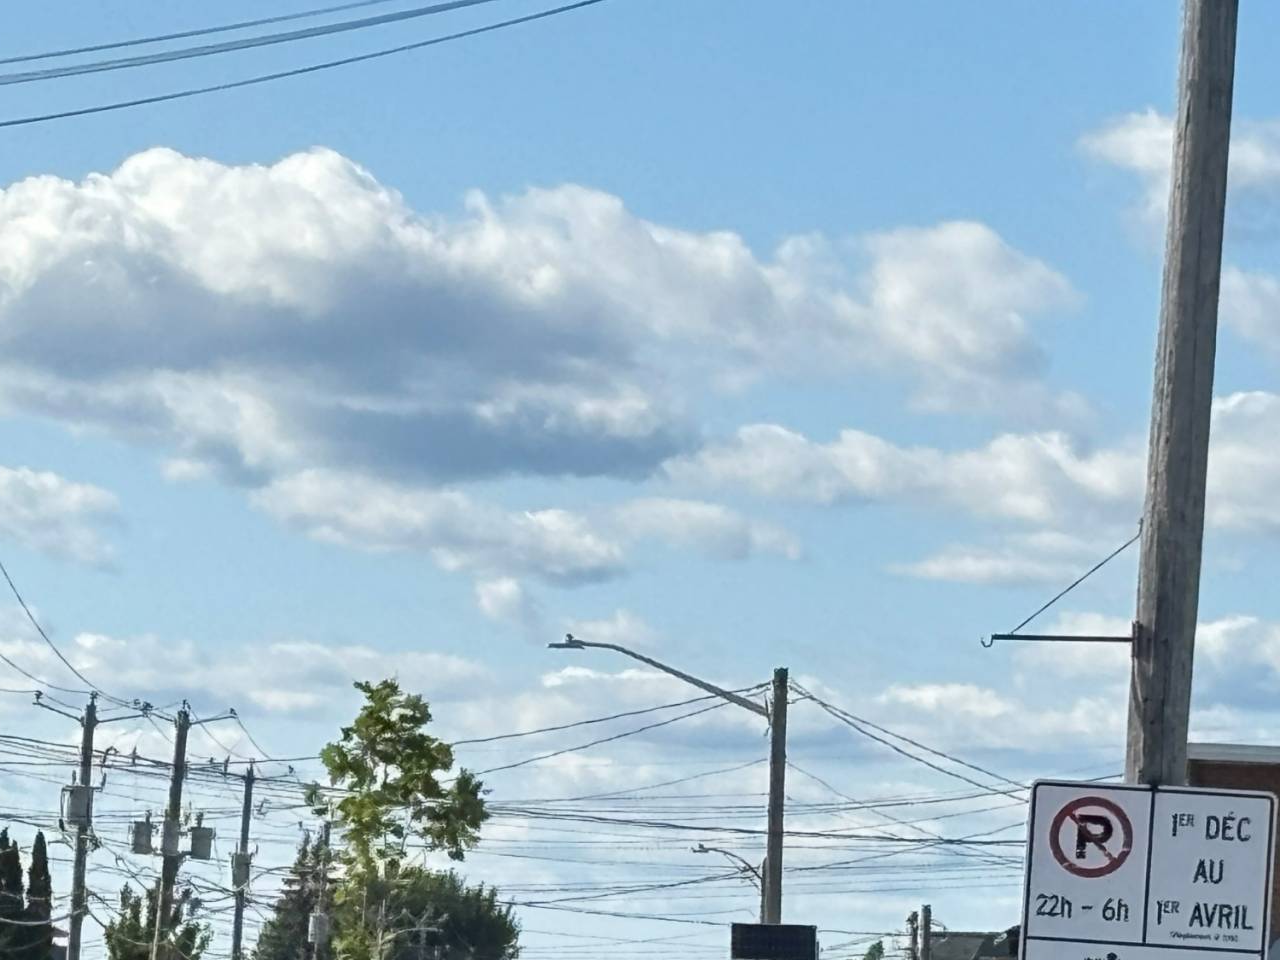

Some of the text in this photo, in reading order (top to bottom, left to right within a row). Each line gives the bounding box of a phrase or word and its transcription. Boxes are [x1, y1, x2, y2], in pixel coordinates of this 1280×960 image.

[1205, 811, 1251, 842] DÉC
[1192, 858, 1224, 884] AU
[1036, 893, 1072, 918] 22h
[1102, 898, 1129, 922] 6h
[1188, 902, 1254, 930] AVRIL
